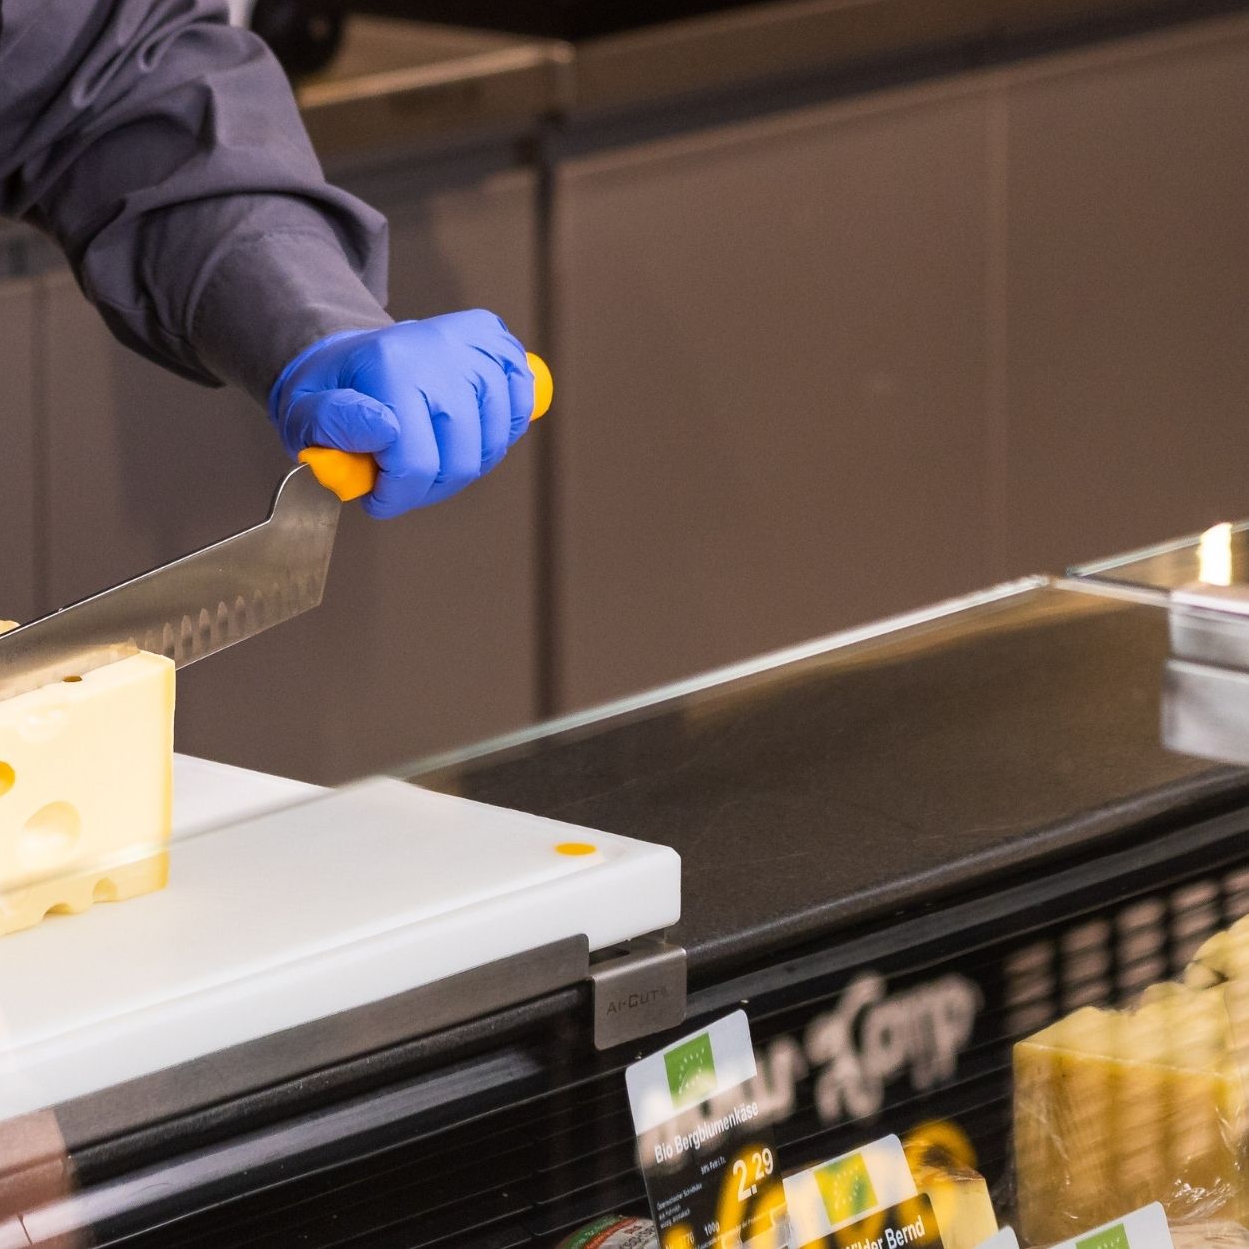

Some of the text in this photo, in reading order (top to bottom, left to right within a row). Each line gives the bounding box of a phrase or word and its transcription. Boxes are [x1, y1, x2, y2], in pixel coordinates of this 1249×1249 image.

[654, 1101, 759, 1164] Bio Bergblumenkäse
[732, 1147, 774, 1203] 2.29
[884, 1214, 926, 1249] Bernd
